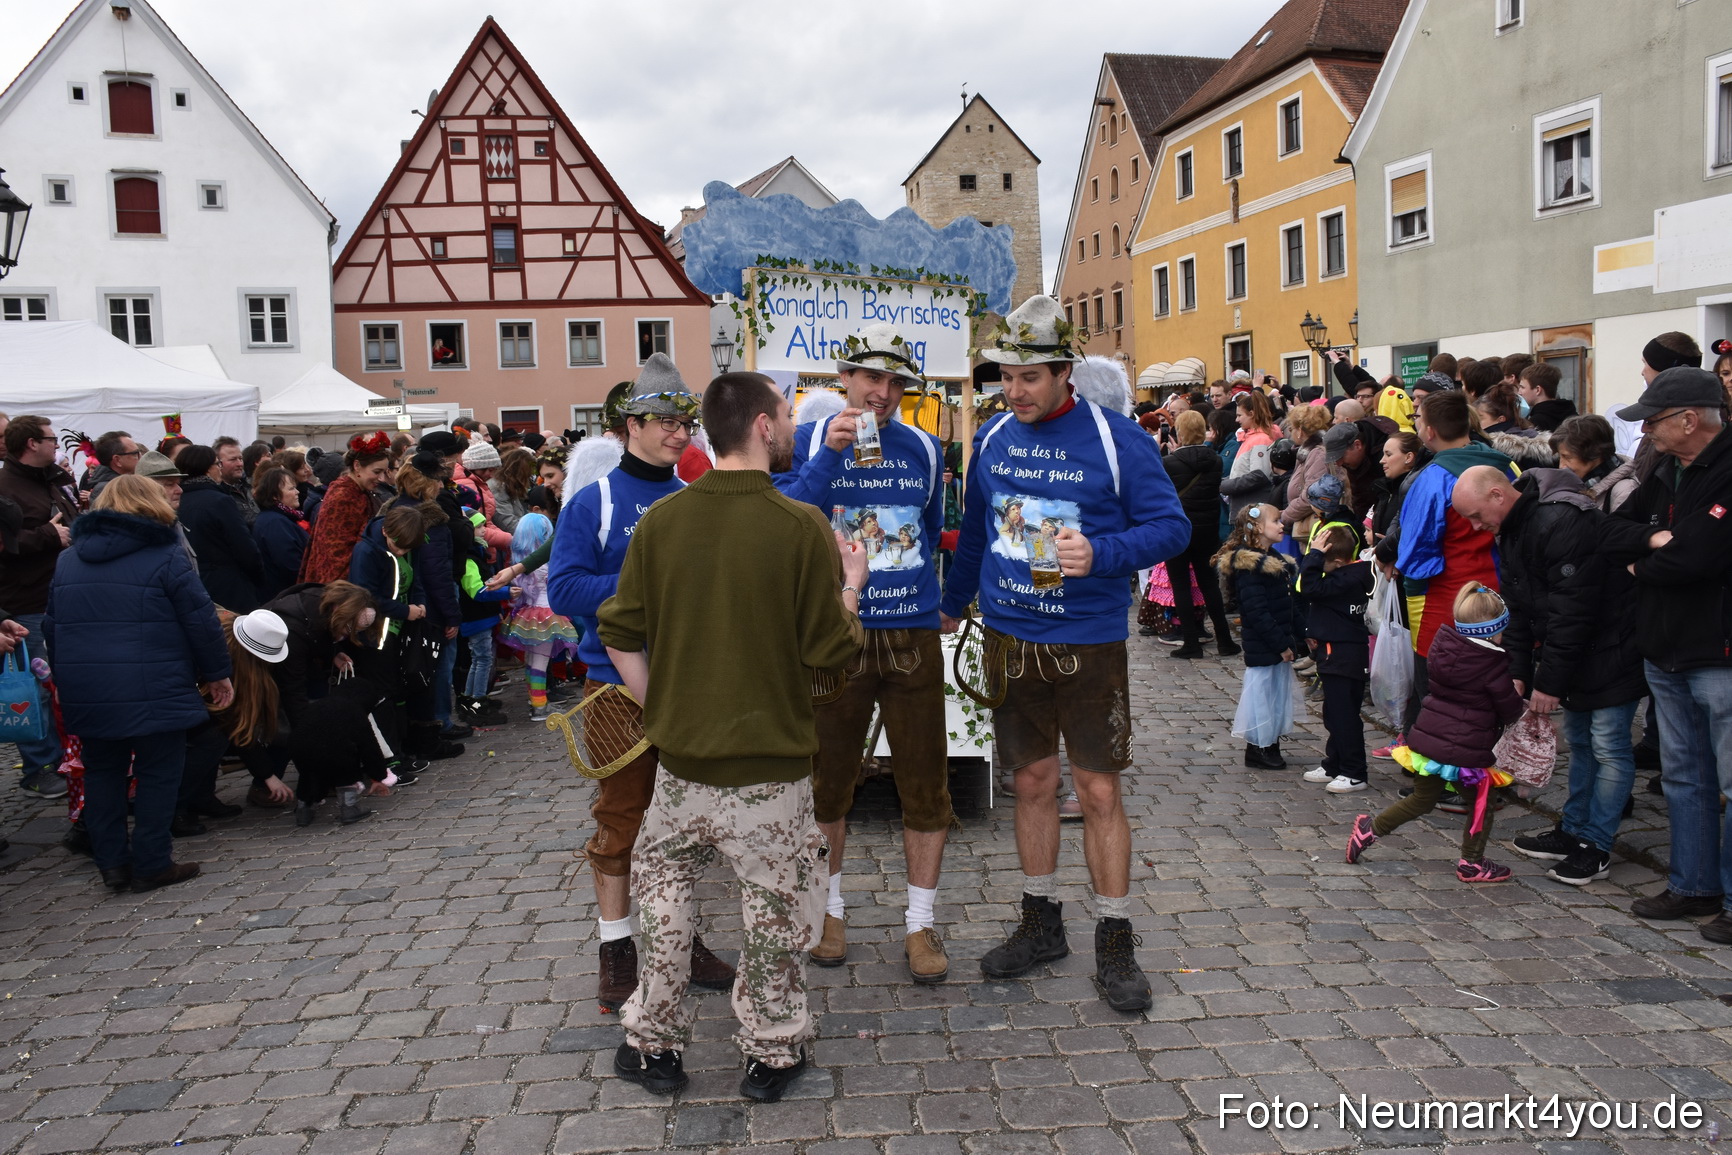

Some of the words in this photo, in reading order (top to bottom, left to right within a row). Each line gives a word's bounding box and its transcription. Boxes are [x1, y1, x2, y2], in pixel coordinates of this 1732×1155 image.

[762, 283, 848, 326] Königlich
[862, 289, 961, 330] Bayrisches
[1293, 360, 1307, 370] BW
[1031, 444, 1051, 459] des
[1055, 448, 1066, 460] is
[896, 459, 908, 469] is
[991, 462, 1012, 475] scho
[1014, 467, 1045, 479] immer
[1048, 469, 1084, 483] gwieß
[831, 476, 856, 489] scho
[859, 478, 894, 489] immer
[868, 586, 909, 599] Oening
[910, 585, 918, 594] is
[870, 603, 919, 615] Paradies
